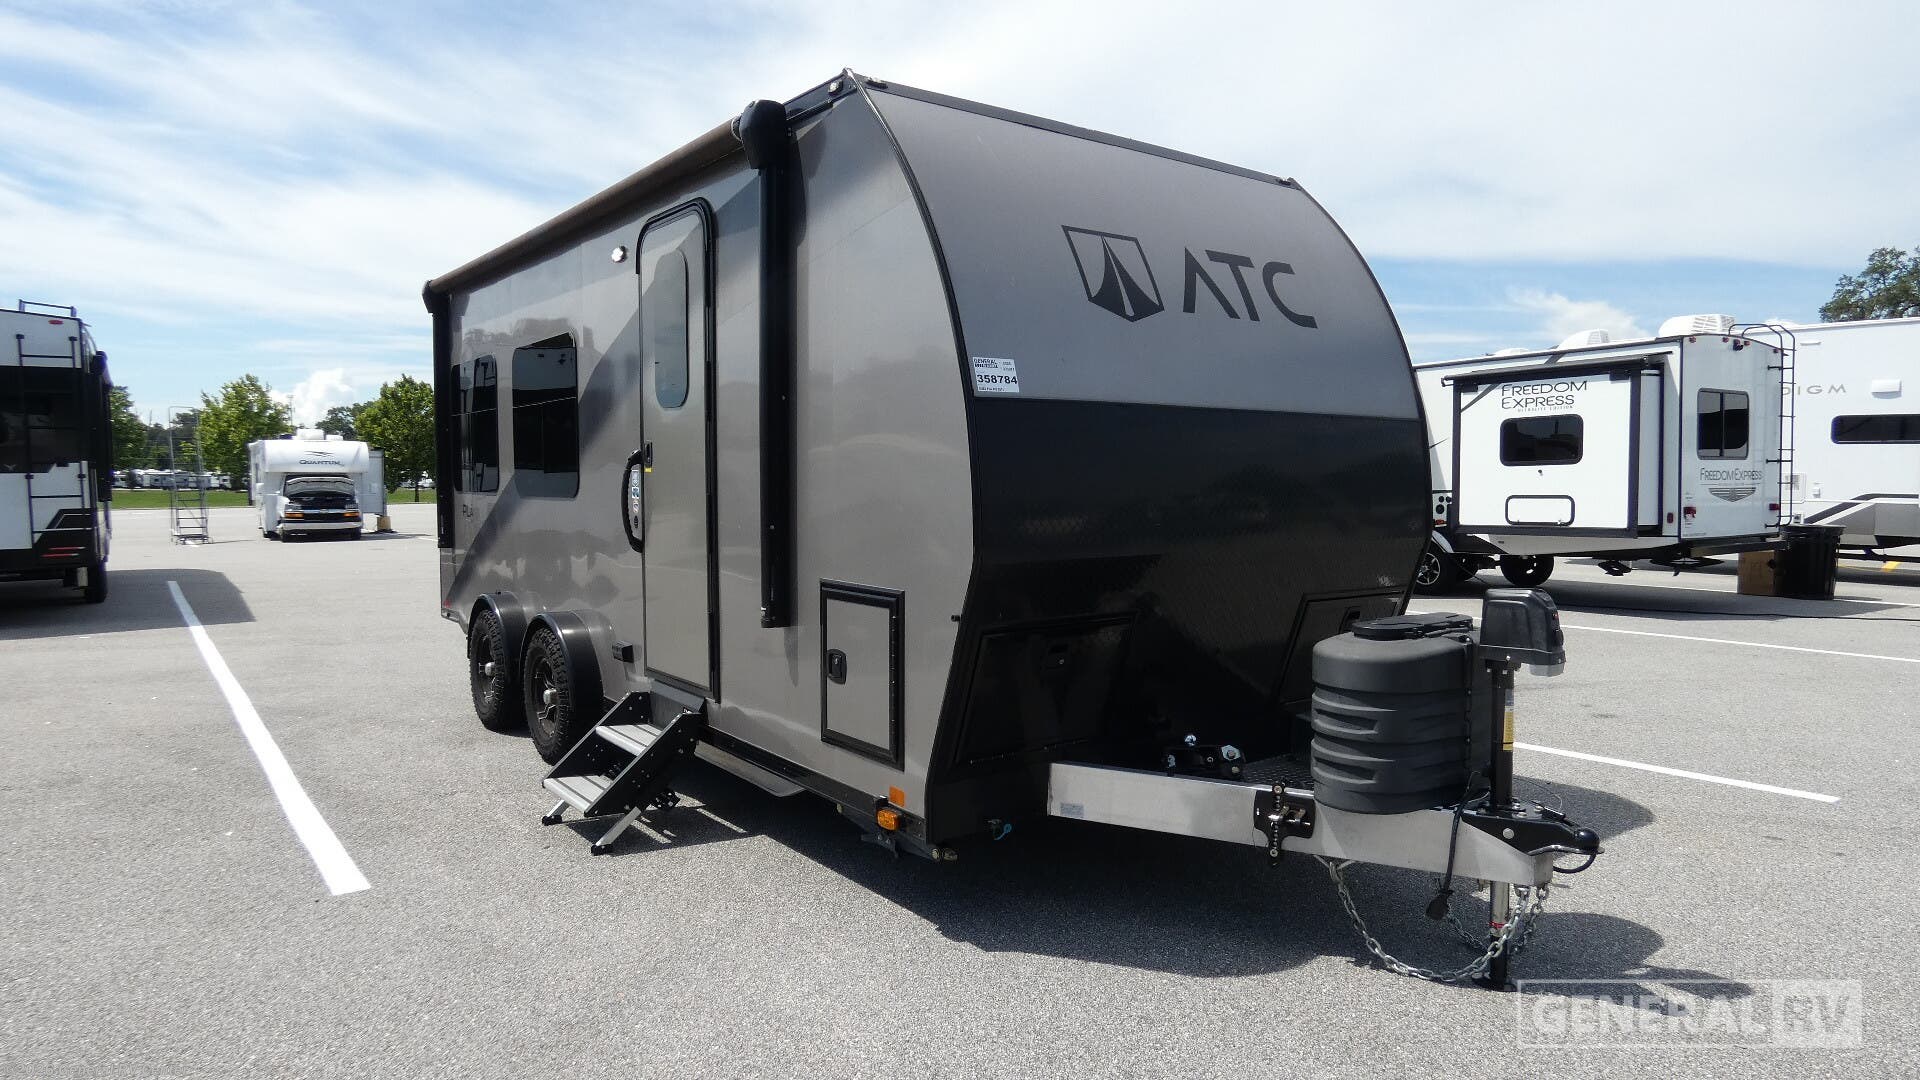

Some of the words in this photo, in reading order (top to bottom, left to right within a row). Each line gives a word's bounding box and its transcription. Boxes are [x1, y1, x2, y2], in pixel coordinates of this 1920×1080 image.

[1183, 247, 1318, 329] ATC
[977, 374, 1018, 385] 358784
[1501, 381, 1587, 396] FREEDOM
[1501, 395, 1574, 409] EXPRESS
